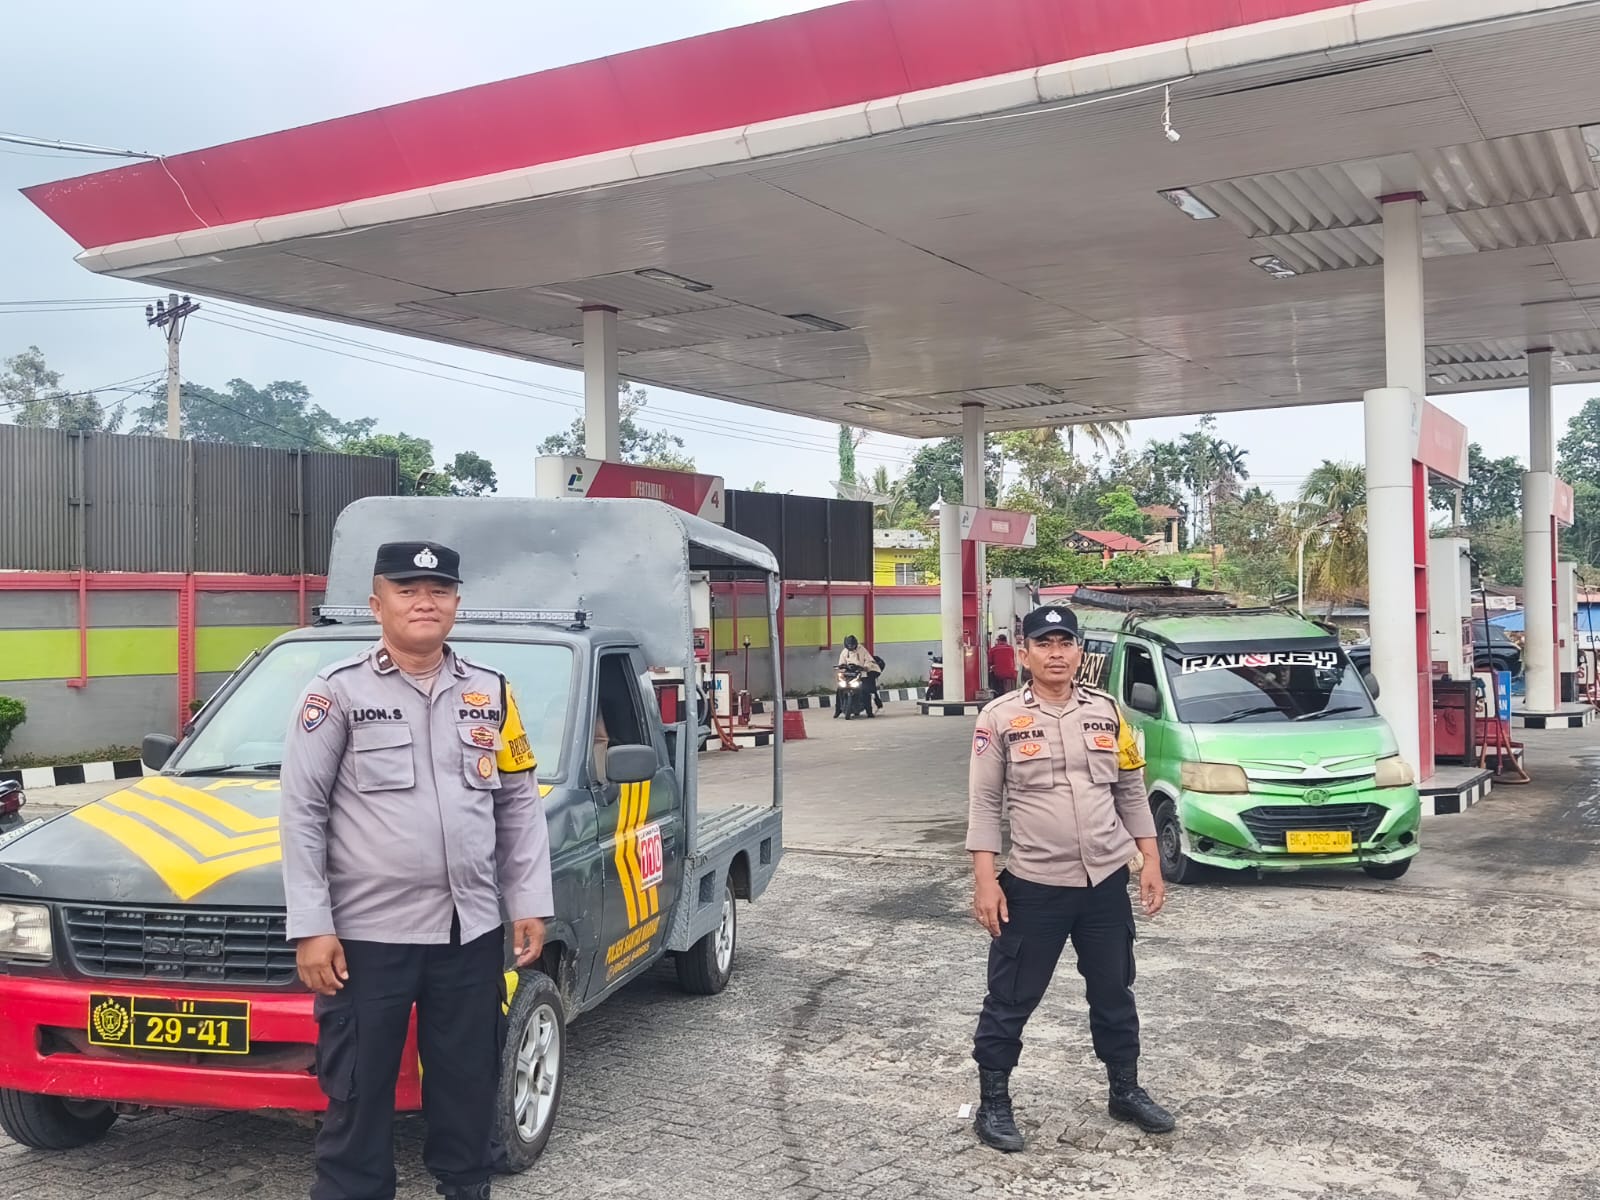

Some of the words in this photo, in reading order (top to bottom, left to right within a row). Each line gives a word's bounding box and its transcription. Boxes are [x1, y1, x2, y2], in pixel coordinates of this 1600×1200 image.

[710, 491, 720, 509] 4
[459, 708, 500, 722] POLRI
[1083, 722, 1114, 732] POLRI
[145, 935, 224, 957] ISUZU
